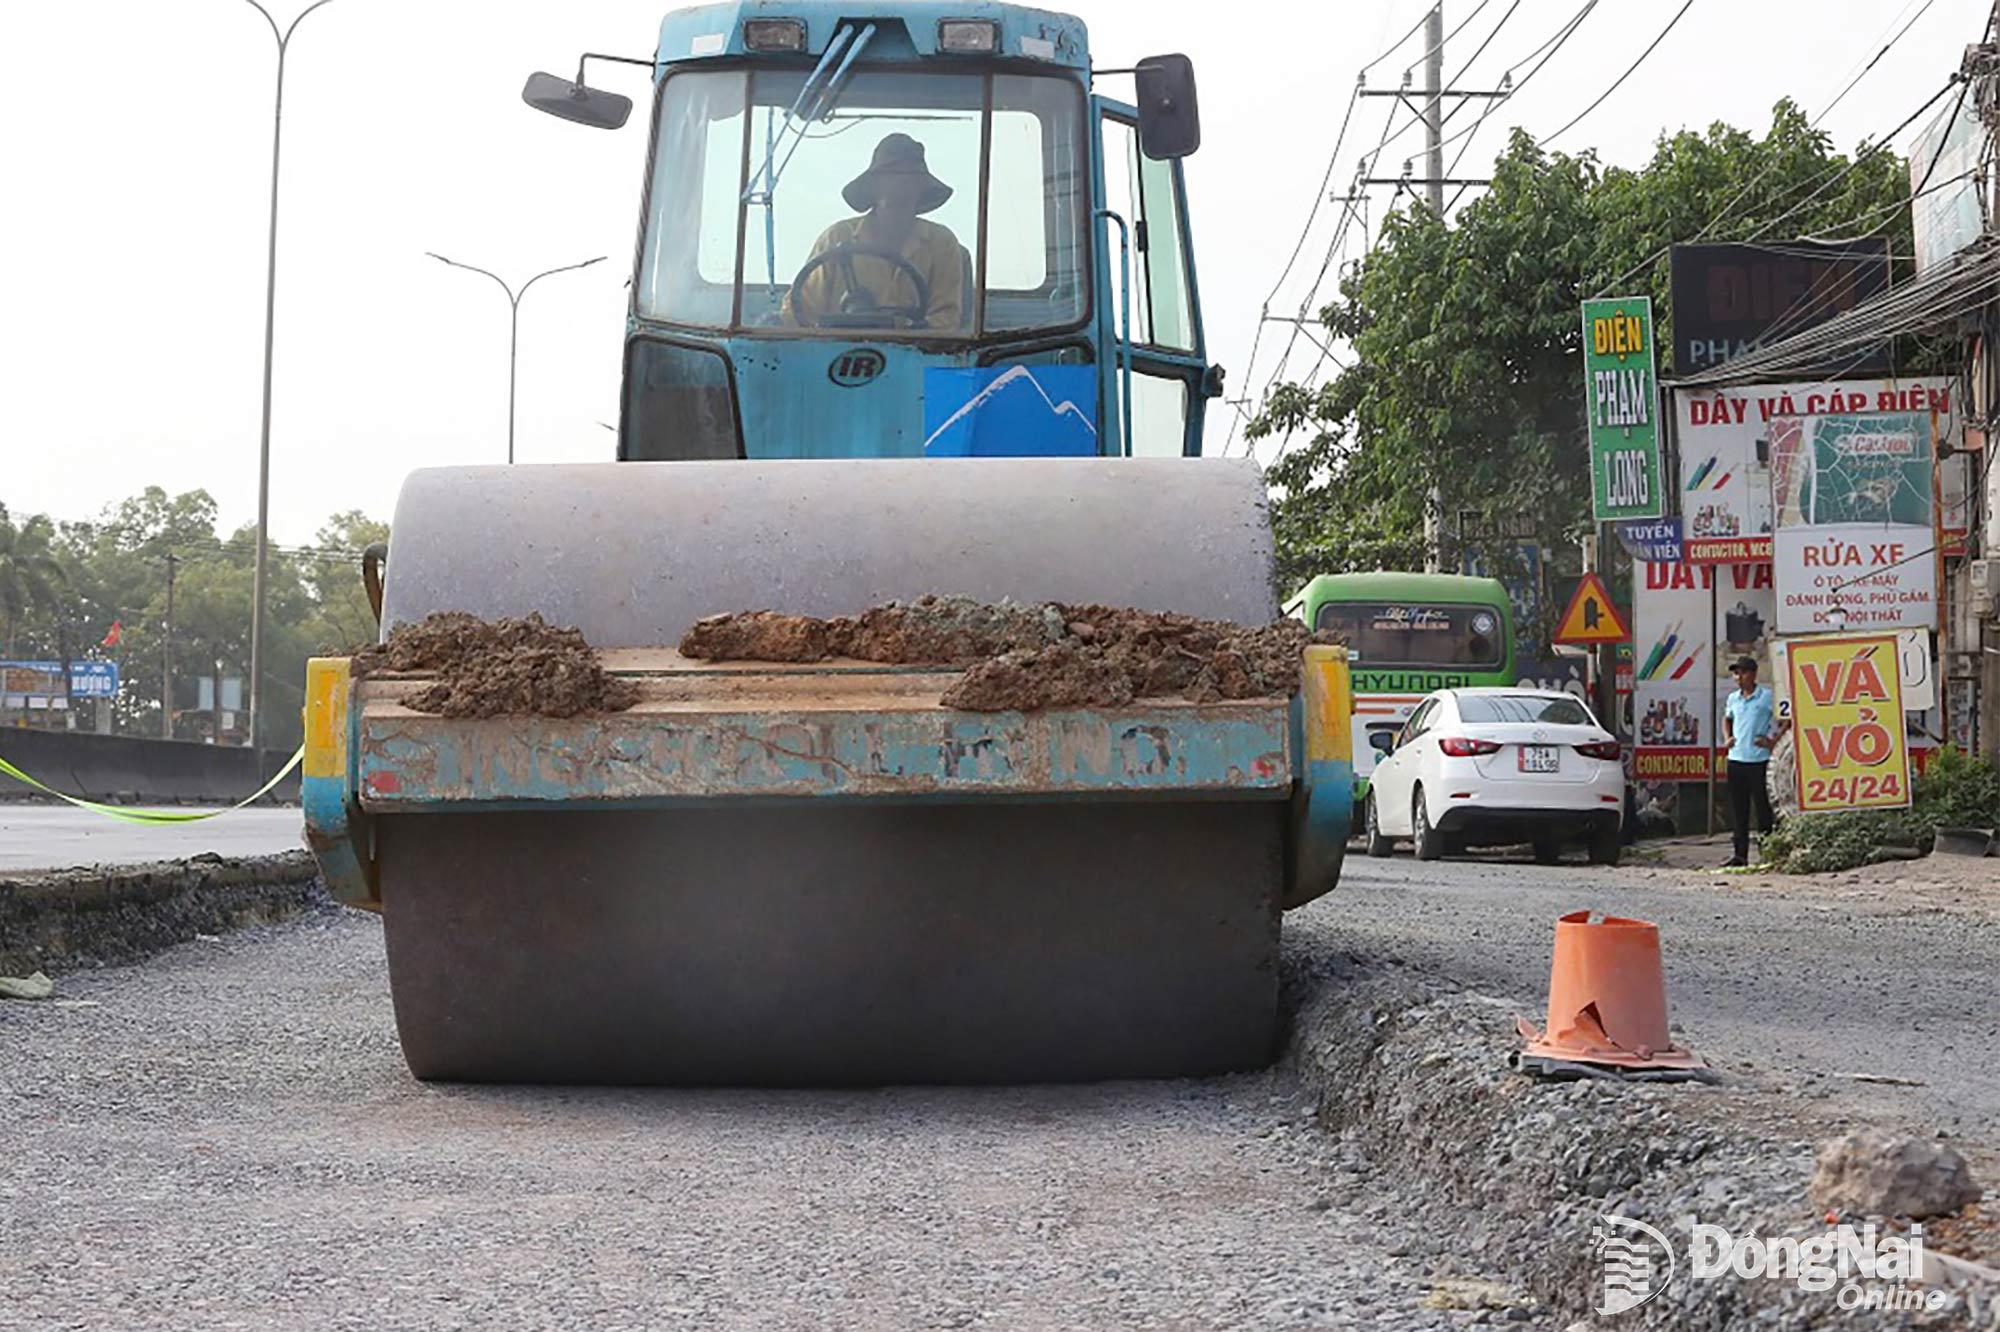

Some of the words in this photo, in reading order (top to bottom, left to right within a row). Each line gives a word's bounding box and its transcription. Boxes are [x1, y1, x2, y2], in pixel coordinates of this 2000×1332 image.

[1594, 309, 1643, 361] ĐIỆN
[1594, 369, 1648, 437] PHẠM
[1690, 393, 1748, 426] DÂY
[1807, 387, 1867, 414] CÁP
[1603, 449, 1648, 507] LONG
[1803, 537, 1863, 567] RỬA
[1352, 674, 1470, 690] HYUNDAI
[1800, 645, 1891, 707] VÁ
[1803, 707, 1893, 769] VỎ
[1637, 755, 1710, 775] CONTACTOR,
[1808, 774, 1901, 804] 24/24
